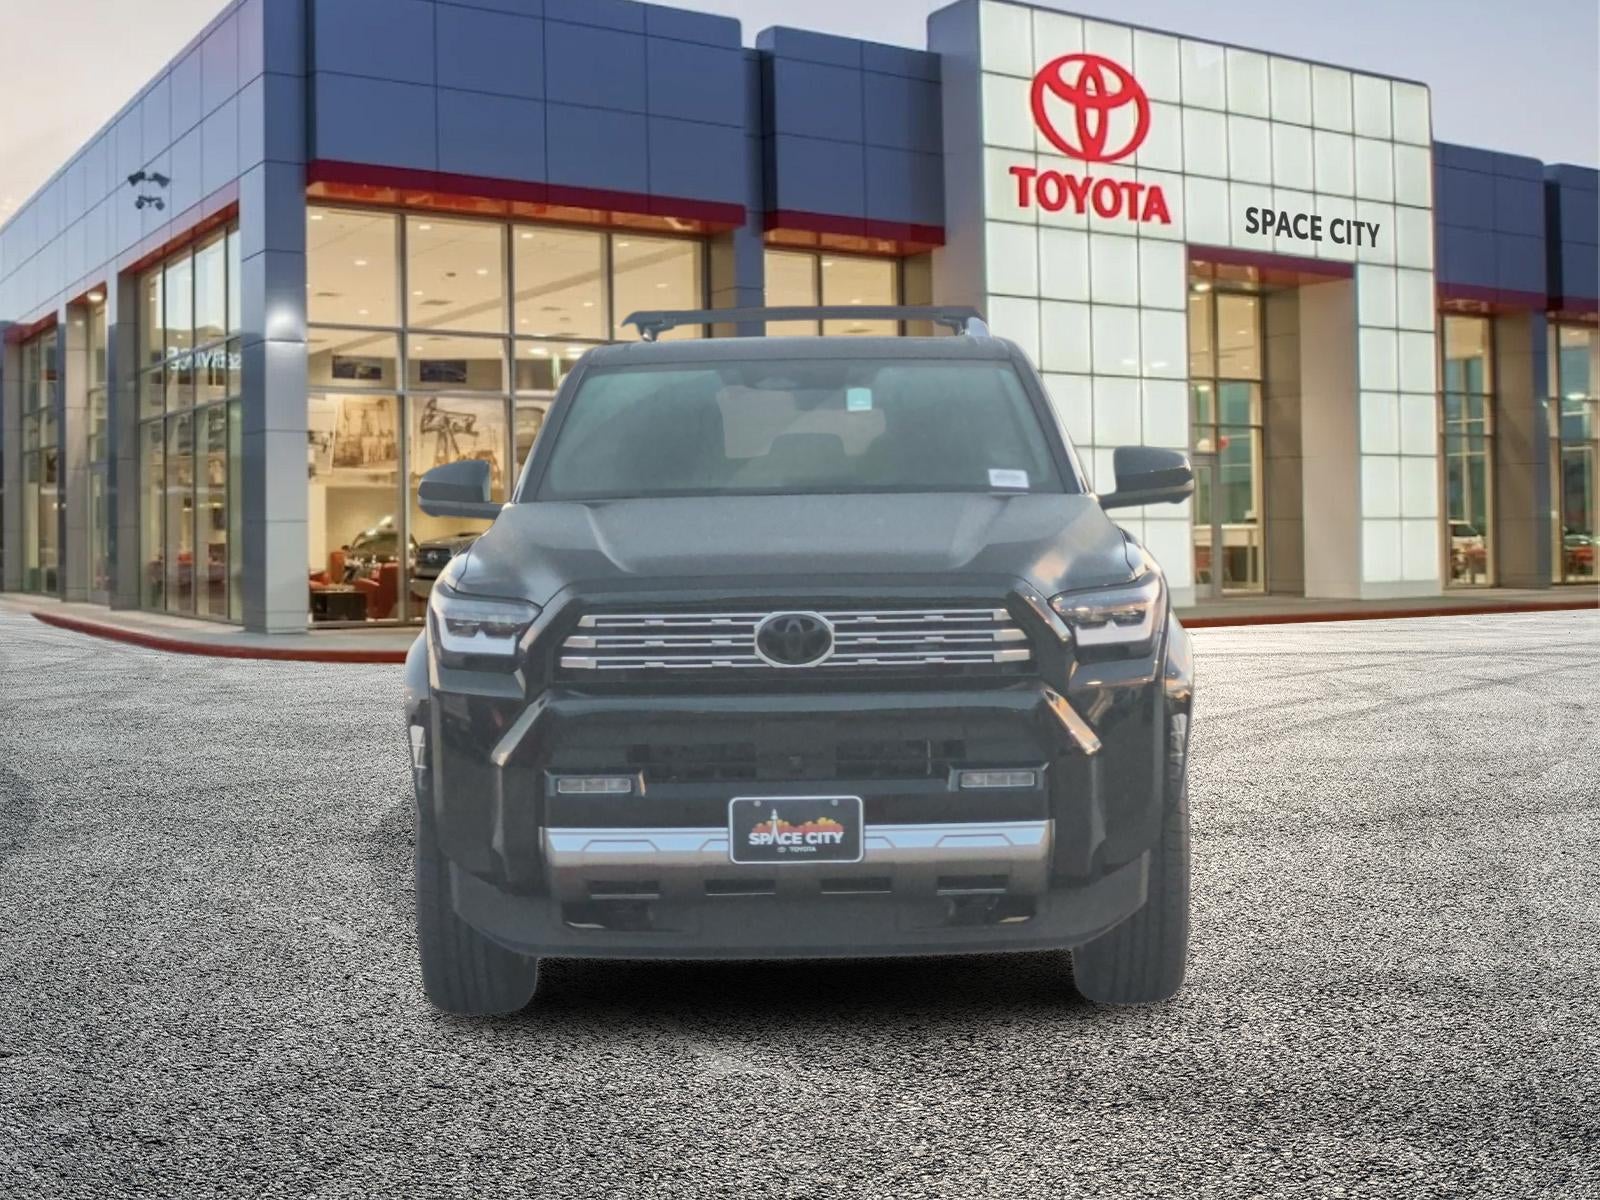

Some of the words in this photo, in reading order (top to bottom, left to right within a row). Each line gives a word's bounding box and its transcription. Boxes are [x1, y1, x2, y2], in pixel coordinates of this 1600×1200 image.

[1009, 166, 1171, 224] TOYOTA
[1245, 207, 1322, 242] SPACE
[1329, 217, 1380, 248] CITY
[748, 831, 803, 845] SPACE
[805, 831, 844, 844] CITY
